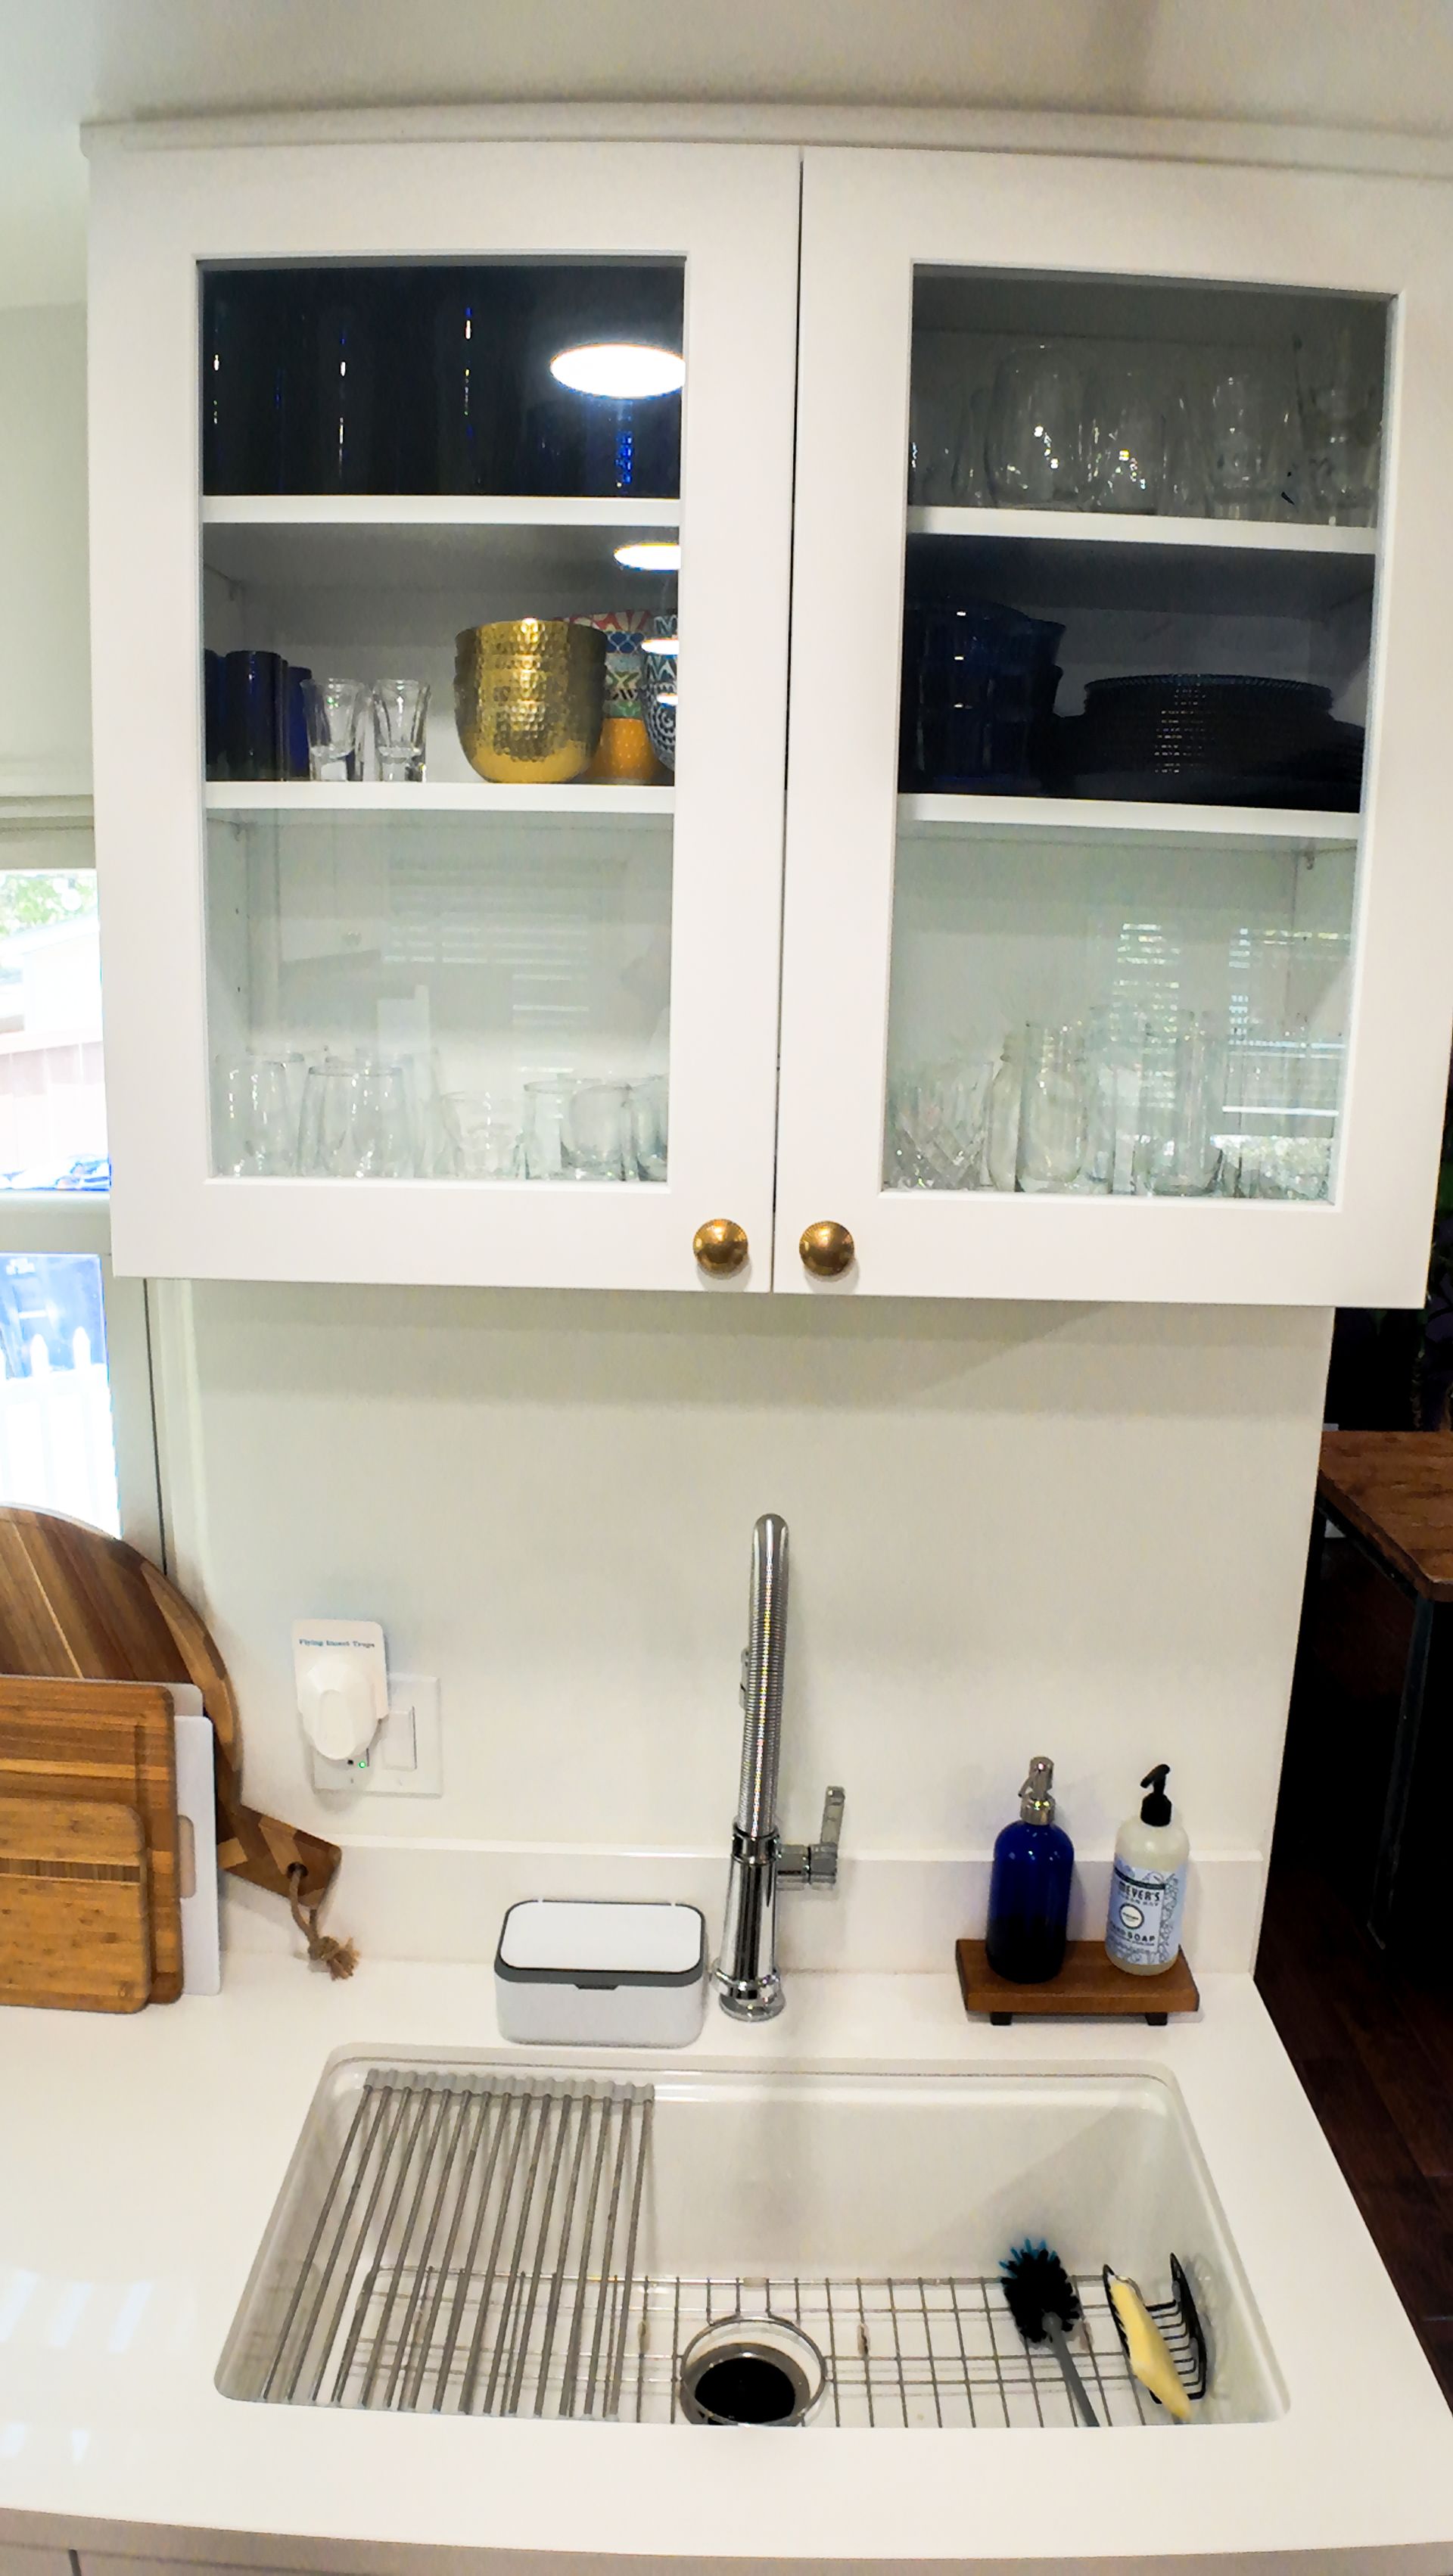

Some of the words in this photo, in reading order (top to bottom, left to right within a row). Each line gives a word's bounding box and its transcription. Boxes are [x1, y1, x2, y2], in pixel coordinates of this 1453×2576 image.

[299, 1638, 324, 1647] Flying
[1119, 1881, 1160, 1901] MEYER'S
[1128, 1931, 1156, 1942] SOAP
